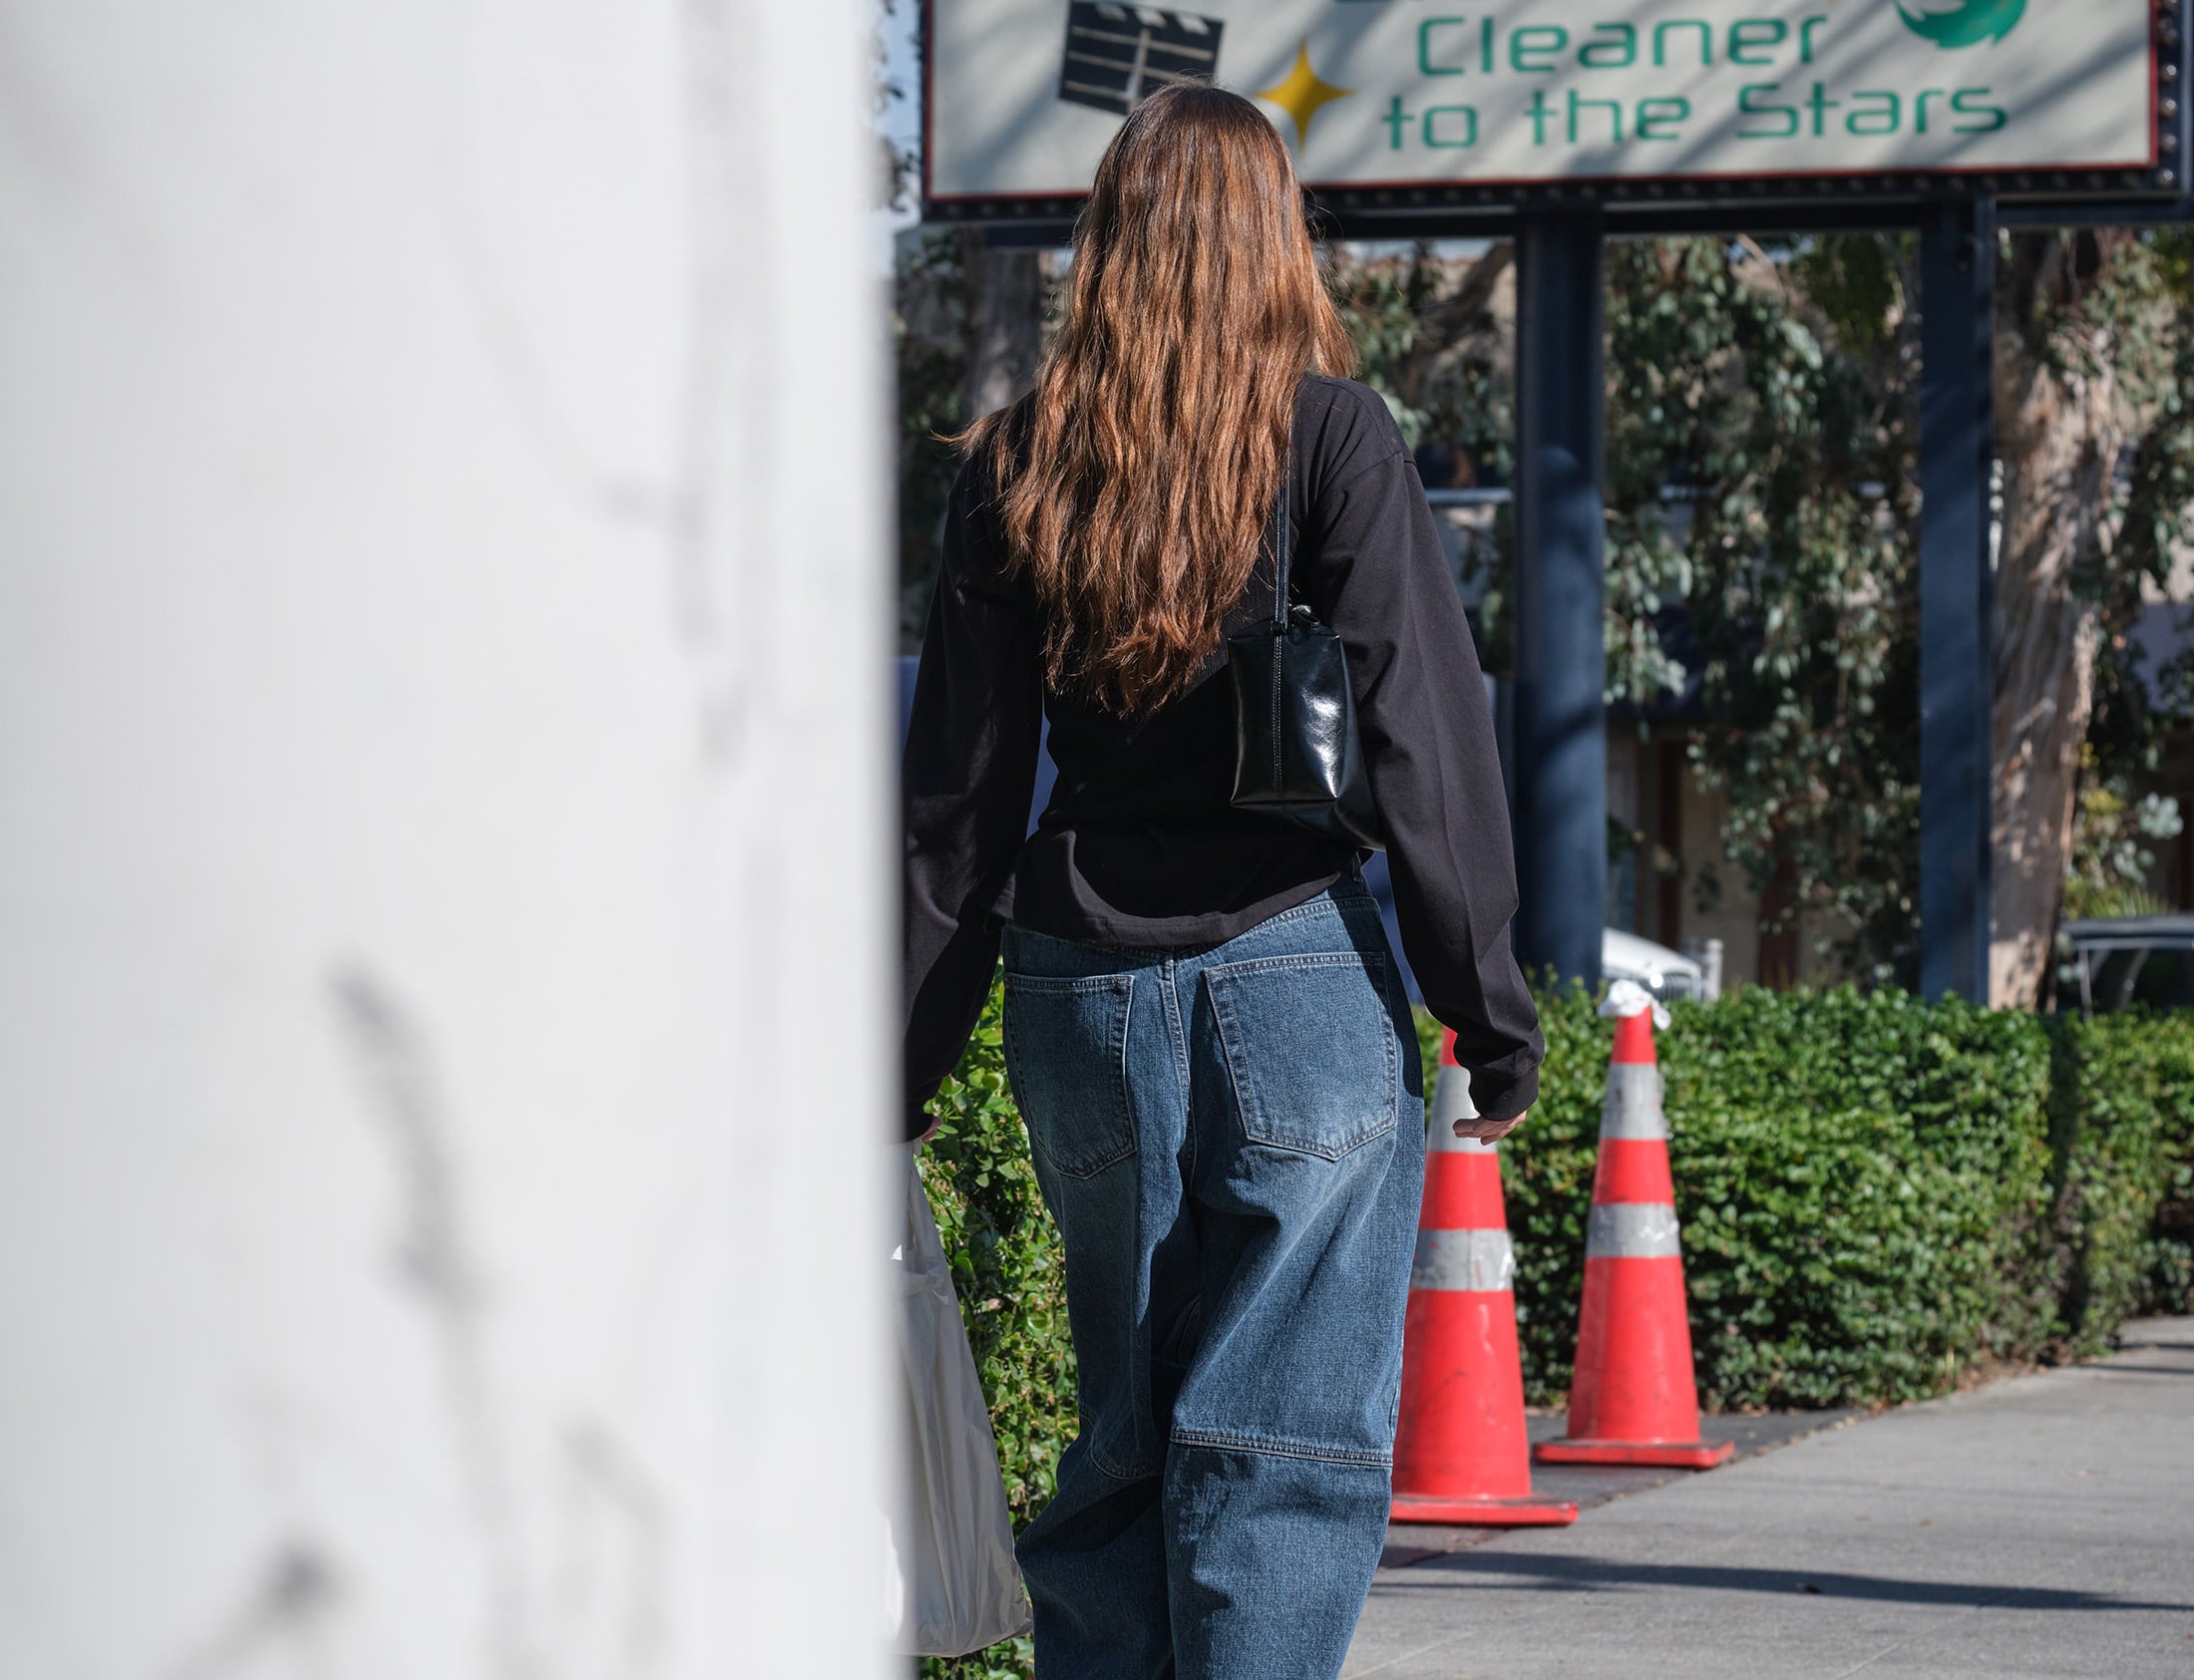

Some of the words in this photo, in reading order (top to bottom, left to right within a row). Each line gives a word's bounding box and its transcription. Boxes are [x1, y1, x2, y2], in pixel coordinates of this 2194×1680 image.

[1416, 16, 1828, 77] Cleaner
[1381, 96, 1479, 151] to
[1523, 88, 1692, 147] the
[1736, 82, 2008, 139] Stars
